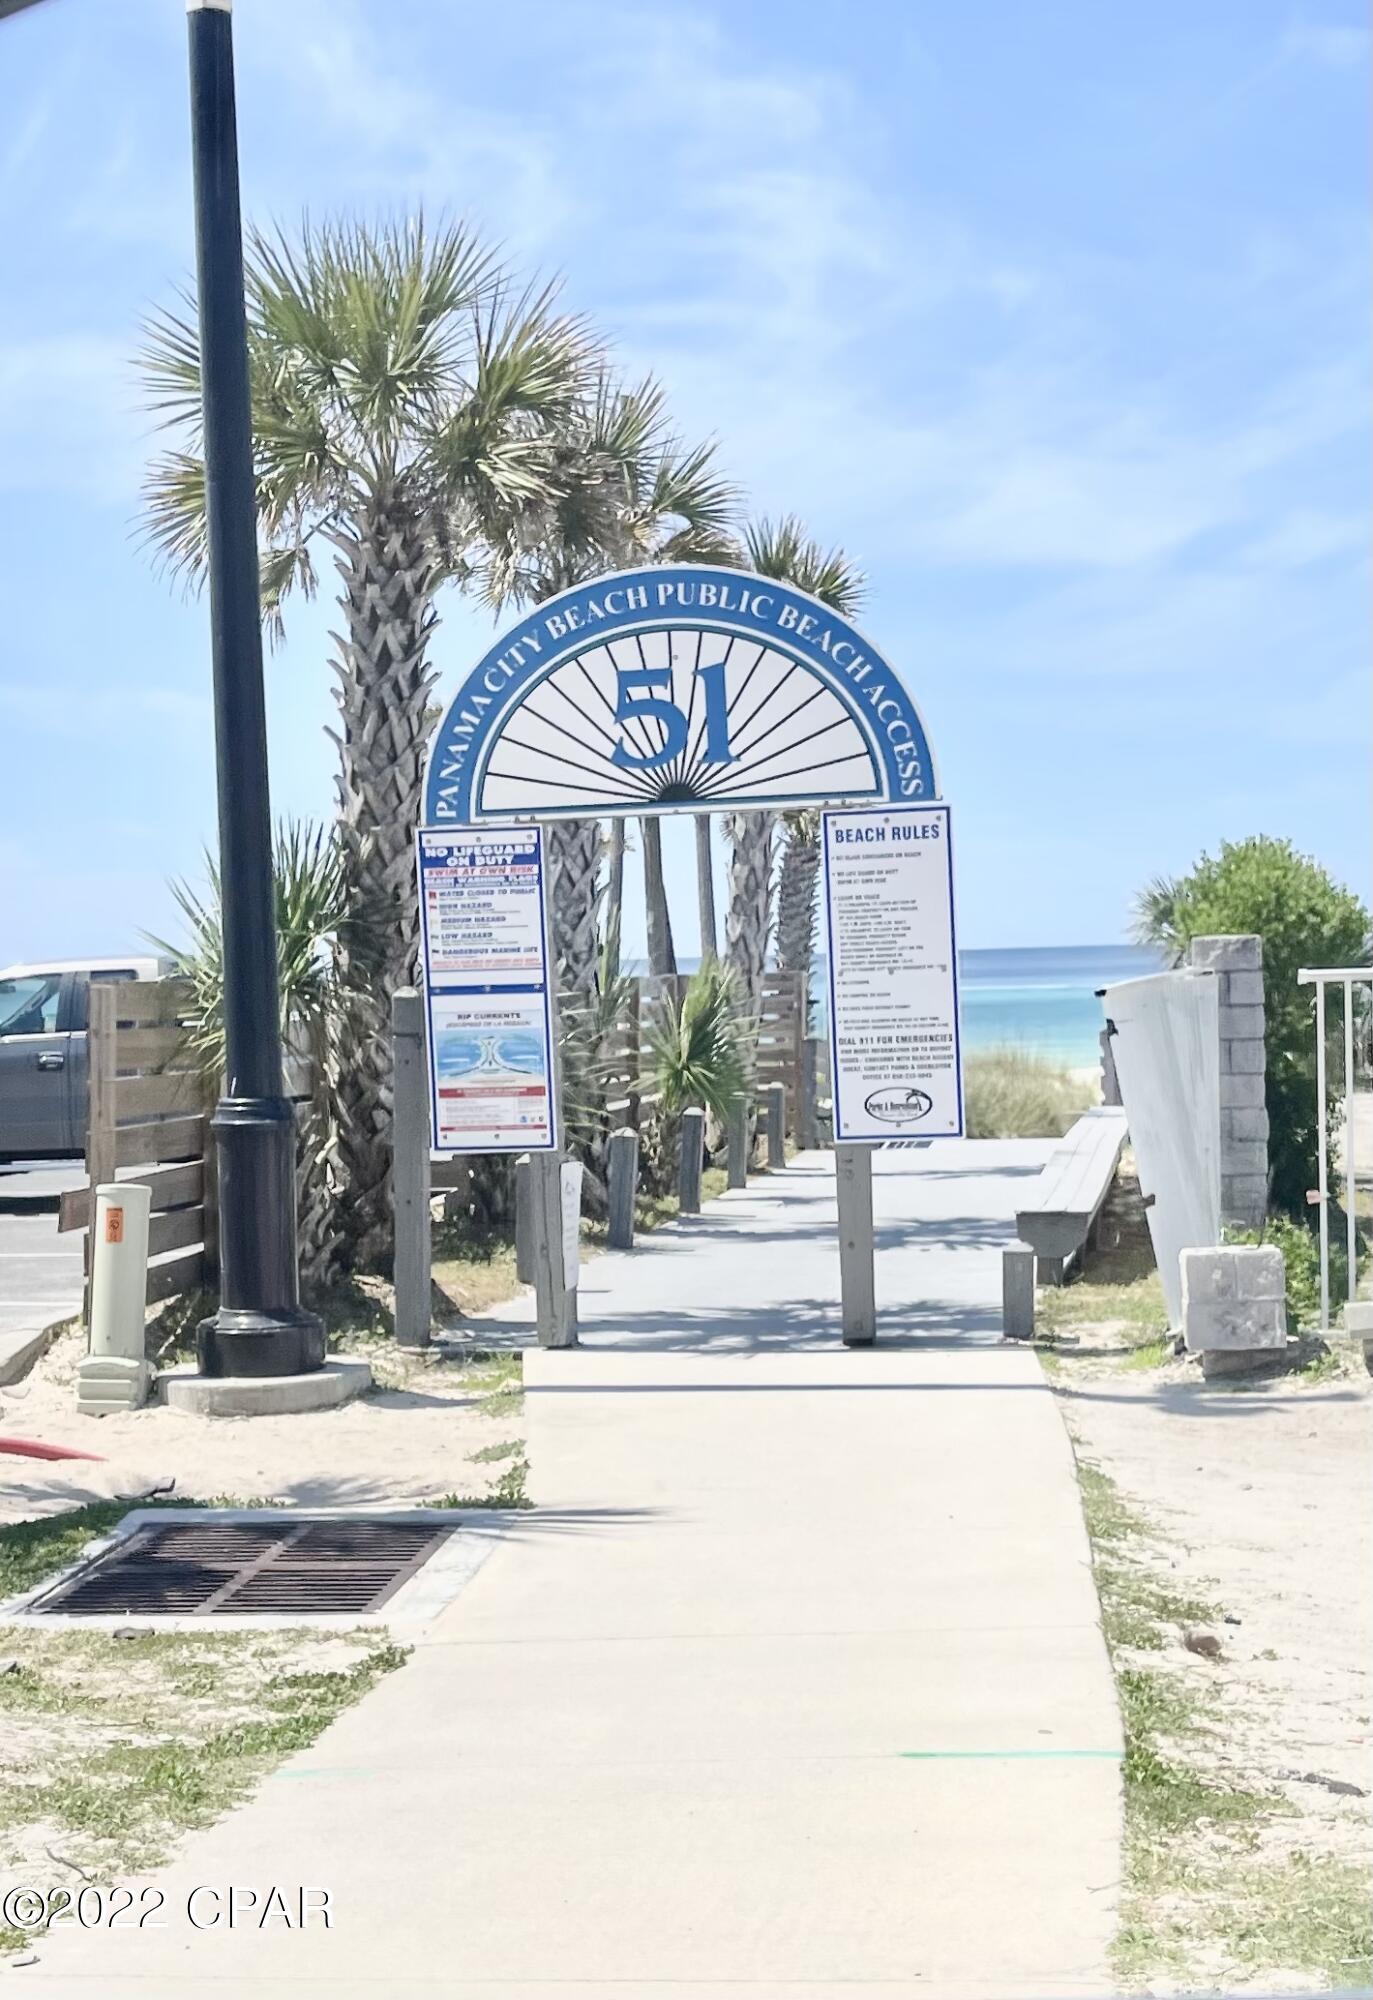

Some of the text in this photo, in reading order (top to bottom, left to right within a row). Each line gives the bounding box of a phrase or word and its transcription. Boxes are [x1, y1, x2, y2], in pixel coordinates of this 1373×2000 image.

[435, 582, 924, 818] PANAMA CITY BEACH PUBLIC BEACH ACCESS
[610, 661, 741, 769] 51
[835, 824, 940, 843] BEACH RULES
[424, 844, 536, 858] NO LIFEGUARD
[446, 854, 515, 867] ON DUTY
[457, 1012, 521, 1021] RIP CURRENTS
[838, 1033, 953, 1046] DIAL 911 FOR EMERGENCIES
